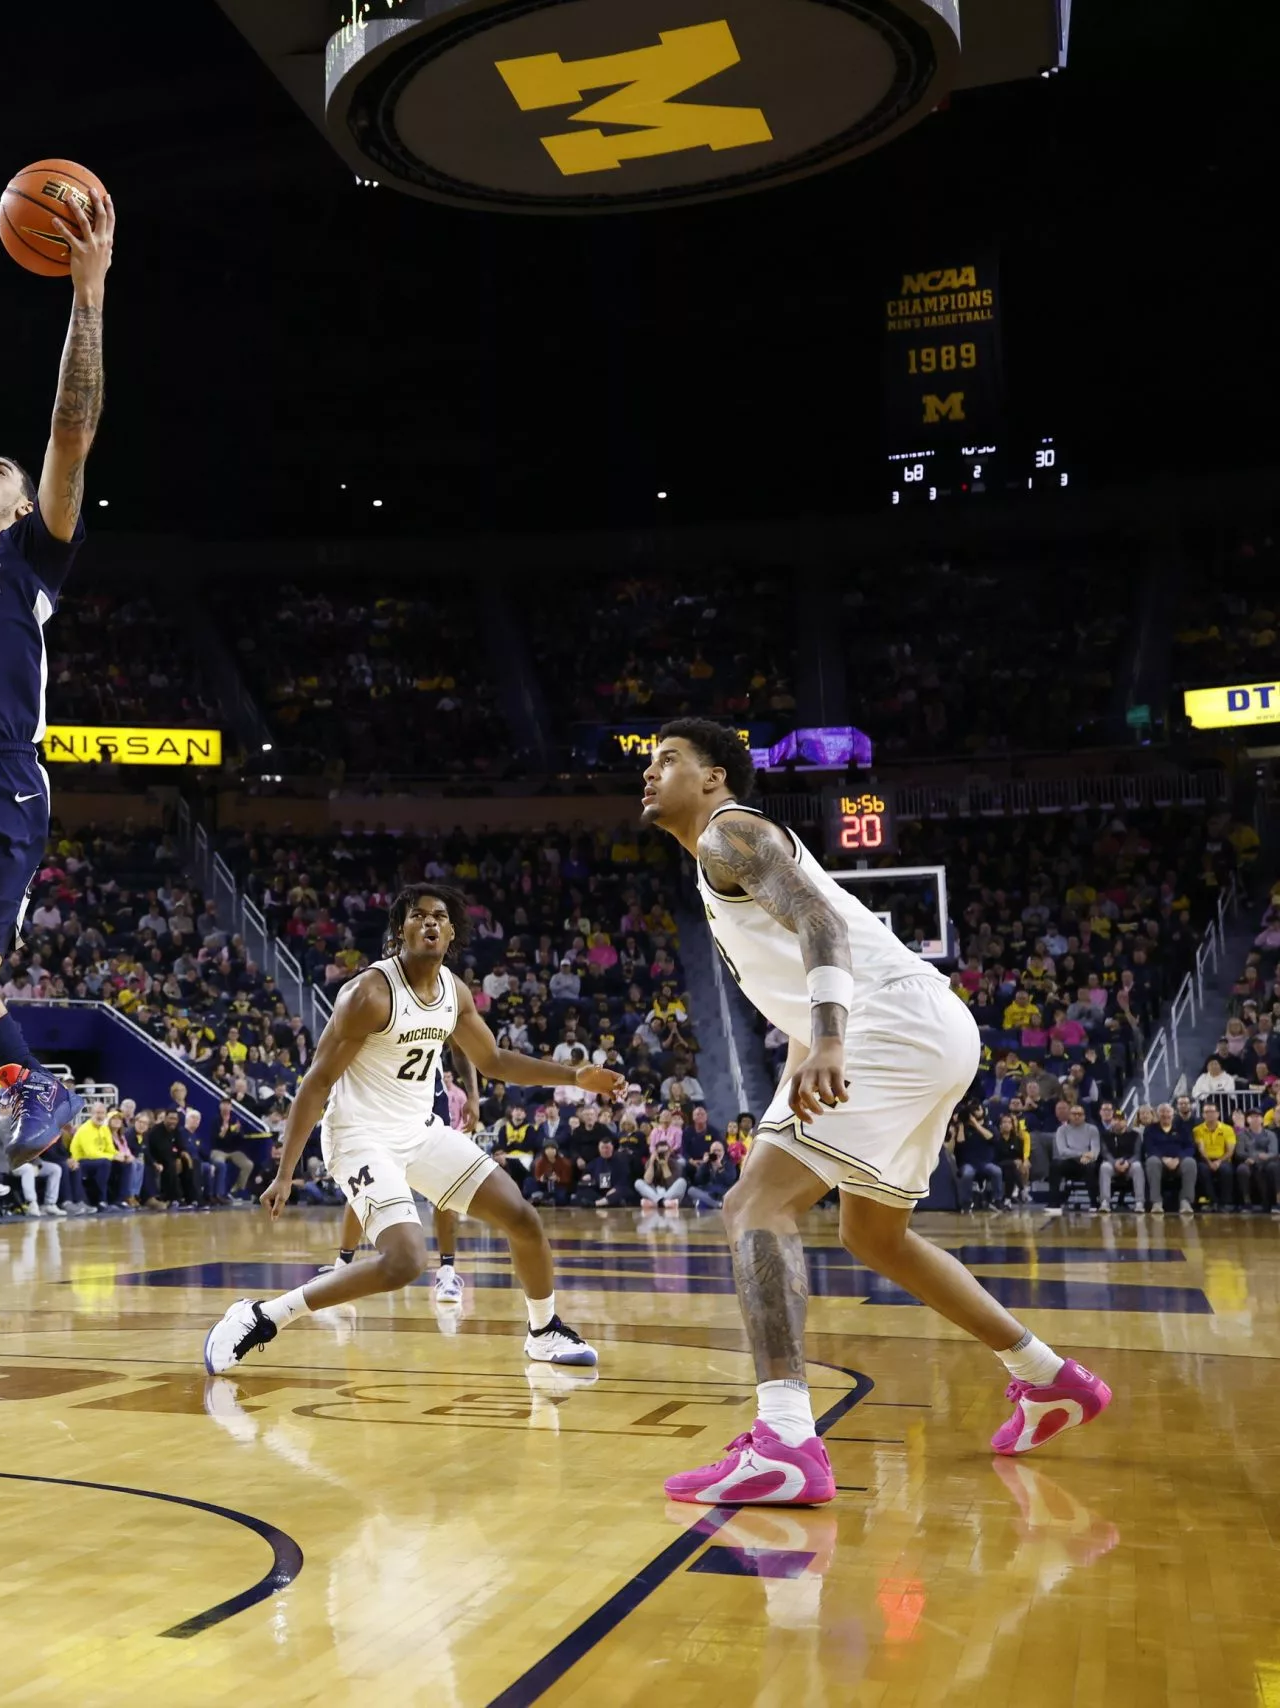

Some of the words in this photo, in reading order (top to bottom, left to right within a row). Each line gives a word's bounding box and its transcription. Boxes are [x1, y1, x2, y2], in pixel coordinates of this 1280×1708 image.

[494, 19, 774, 176] M
[900, 264, 977, 295] NCAA
[886, 289, 993, 317] CHAMPIONS
[923, 309, 994, 328] BASKETBALL
[908, 341, 977, 375] 1989
[921, 391, 966, 424] M
[1035, 449, 1055, 468] 30
[903, 463, 924, 483] 68
[973, 464, 982, 479] 2
[1060, 473, 1069, 487] 3
[892, 490, 900, 505] 3
[929, 486, 937, 501] 3
[51, 735, 209, 757] NISSAN
[841, 794, 884, 814] 16:56
[841, 815, 881, 849] 20
[397, 1049, 435, 1081] 21
[347, 1165, 374, 1197] M
